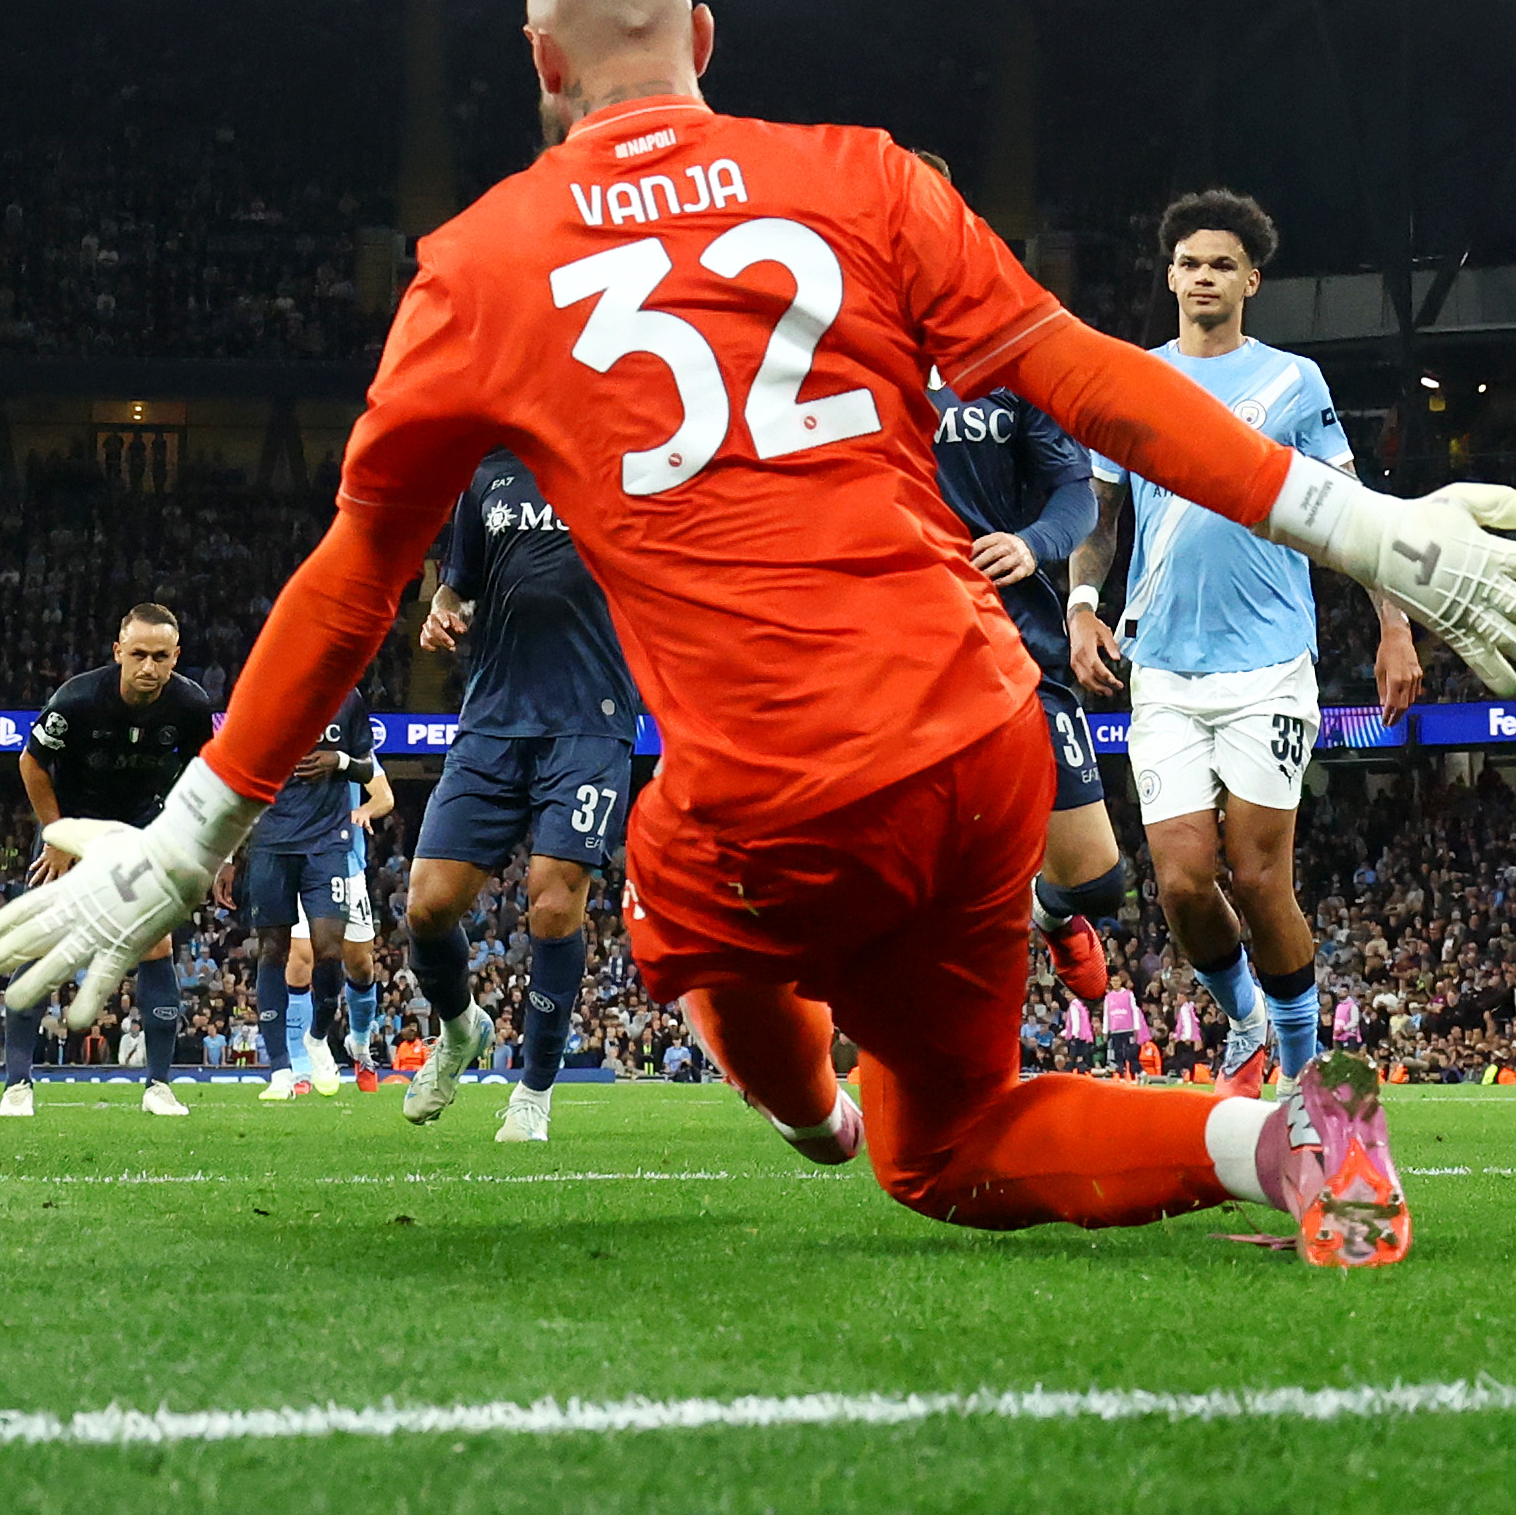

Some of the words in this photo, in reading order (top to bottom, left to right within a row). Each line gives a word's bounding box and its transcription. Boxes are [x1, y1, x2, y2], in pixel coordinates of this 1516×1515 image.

[570, 158, 748, 227] VANJA
[549, 217, 883, 496] 32
[491, 476, 515, 490] EA7
[1056, 706, 1097, 768] 31
[1270, 713, 1305, 767] 33
[571, 784, 618, 837] 37
